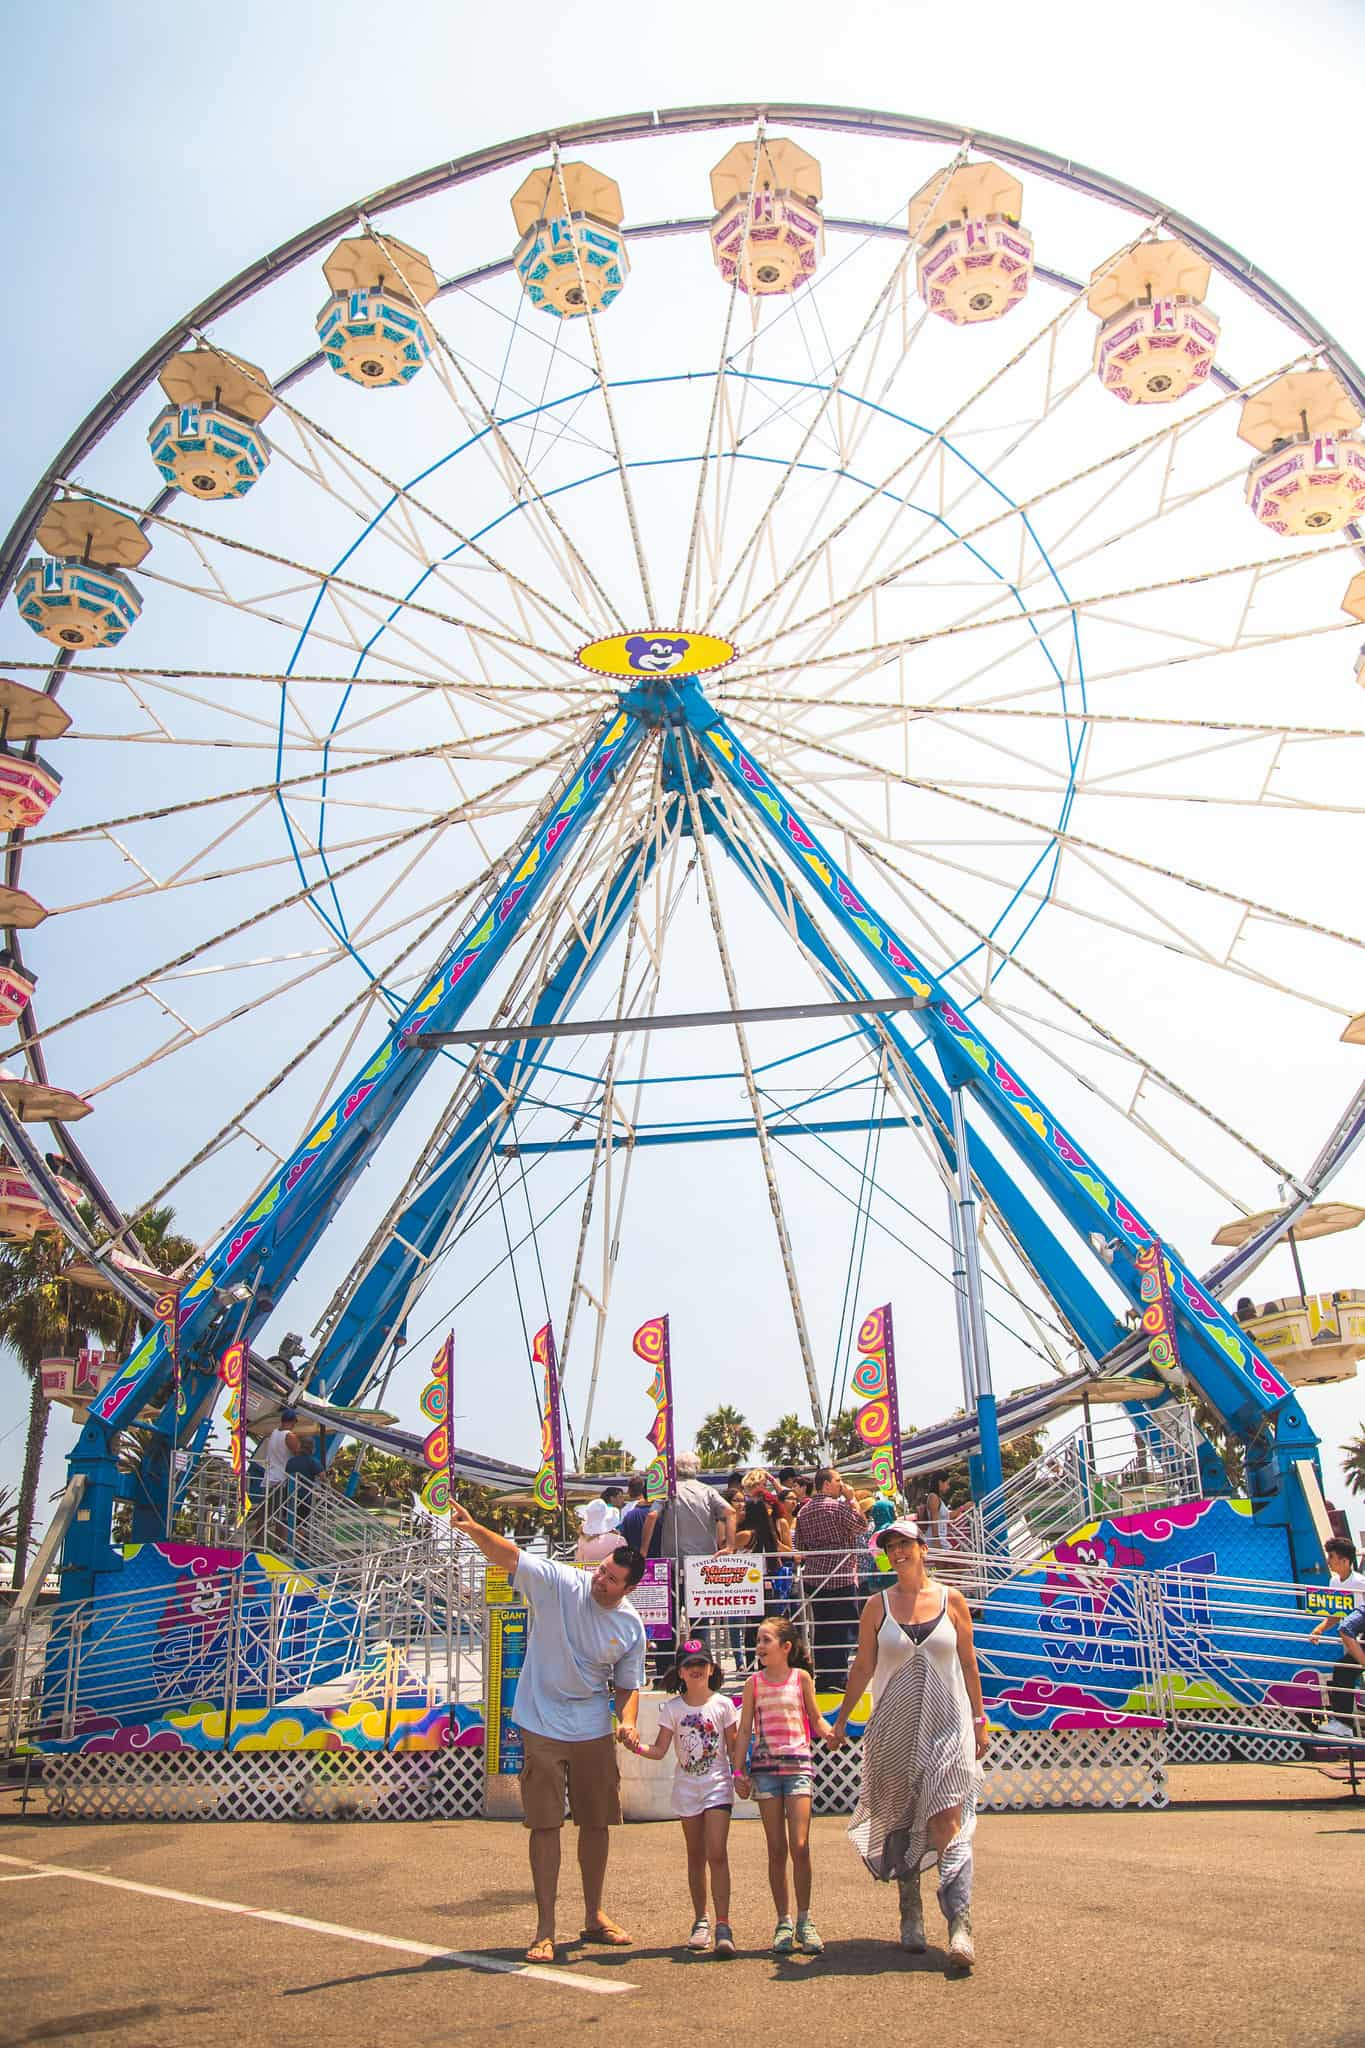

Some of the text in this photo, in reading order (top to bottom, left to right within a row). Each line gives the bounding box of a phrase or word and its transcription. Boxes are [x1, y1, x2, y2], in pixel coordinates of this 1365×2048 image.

[700, 1565, 748, 1577] Midway
[704, 1575, 743, 1587] Magic
[1038, 1552, 1217, 1637] GIANT
[693, 1595, 757, 1607] 7 TICKETS
[1308, 1593, 1354, 1610] ENTER
[500, 1610, 526, 1620] GIANT
[1042, 1637, 1232, 1674] WHEEL
